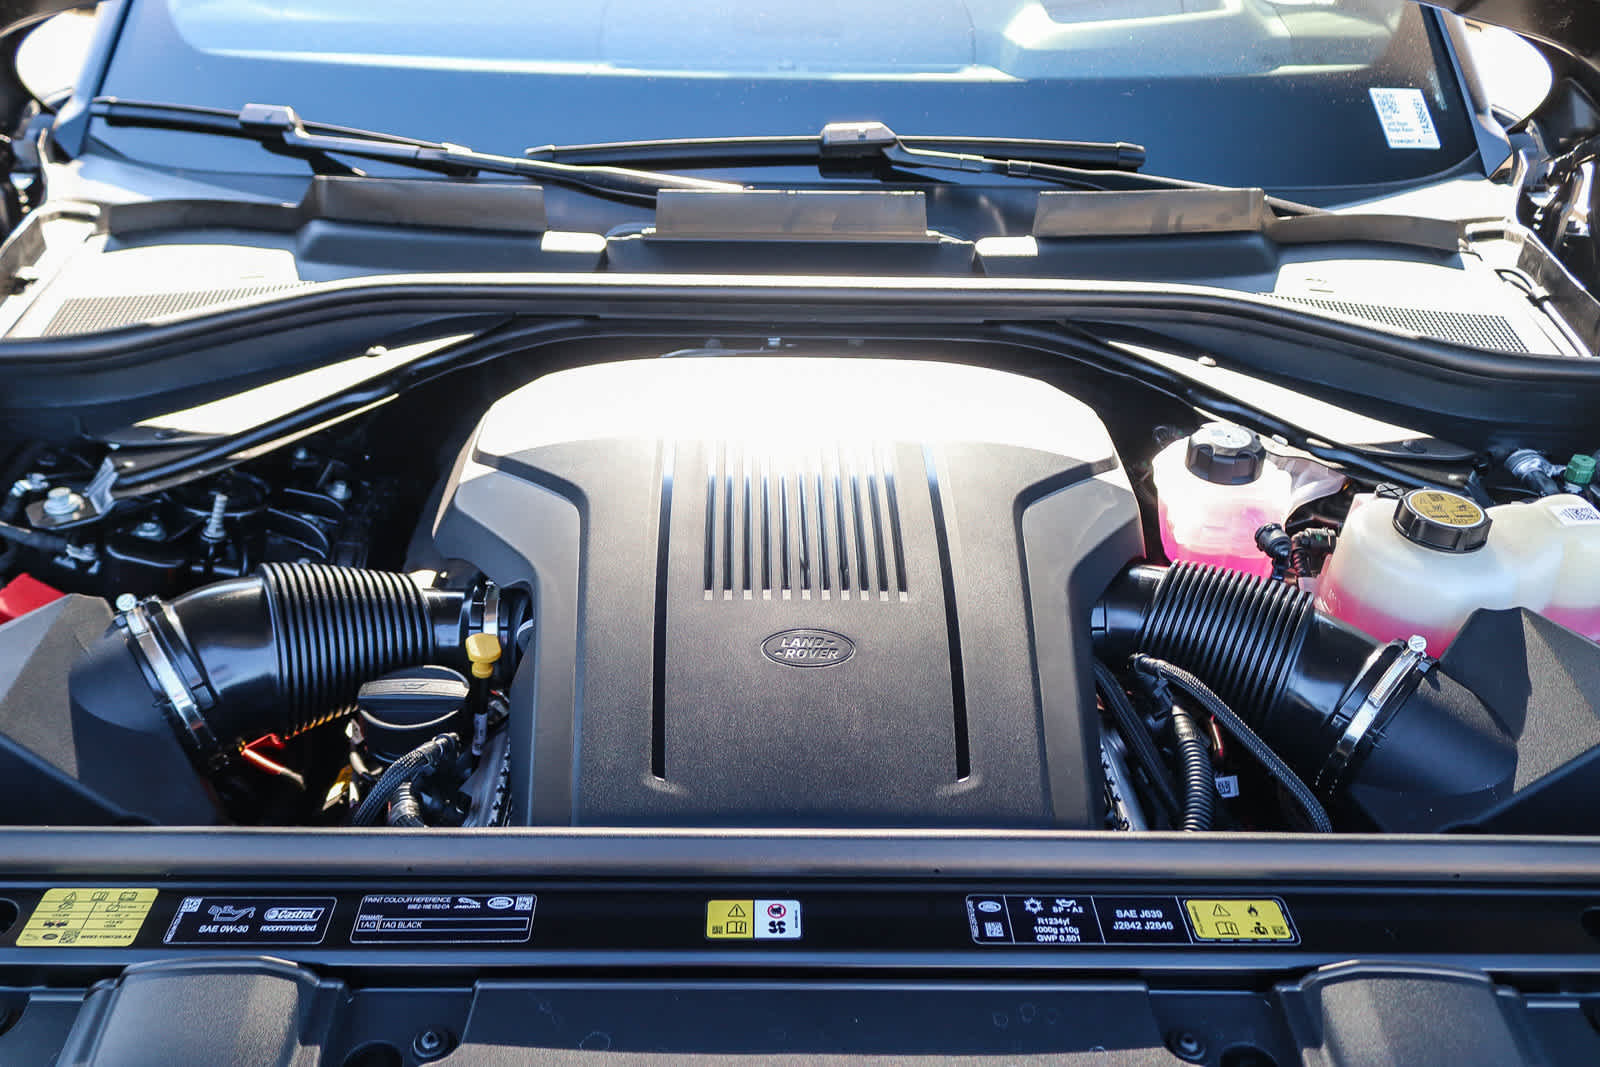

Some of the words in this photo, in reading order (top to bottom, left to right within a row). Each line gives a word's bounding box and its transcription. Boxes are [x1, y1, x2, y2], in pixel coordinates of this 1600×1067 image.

[781, 636, 825, 648] LAND
[784, 647, 840, 659] ROVER
[277, 909, 316, 920] Castrol
[1115, 909, 1138, 919] SAE
[360, 921, 376, 929] 1AG
[382, 921, 397, 929] 1AG
[397, 921, 422, 929] BLACK
[1037, 917, 1070, 926] R1234yf
[198, 924, 218, 934] SAE
[219, 924, 249, 934] 0W-30
[260, 923, 318, 932] recommended
[1036, 934, 1058, 942] GWP
